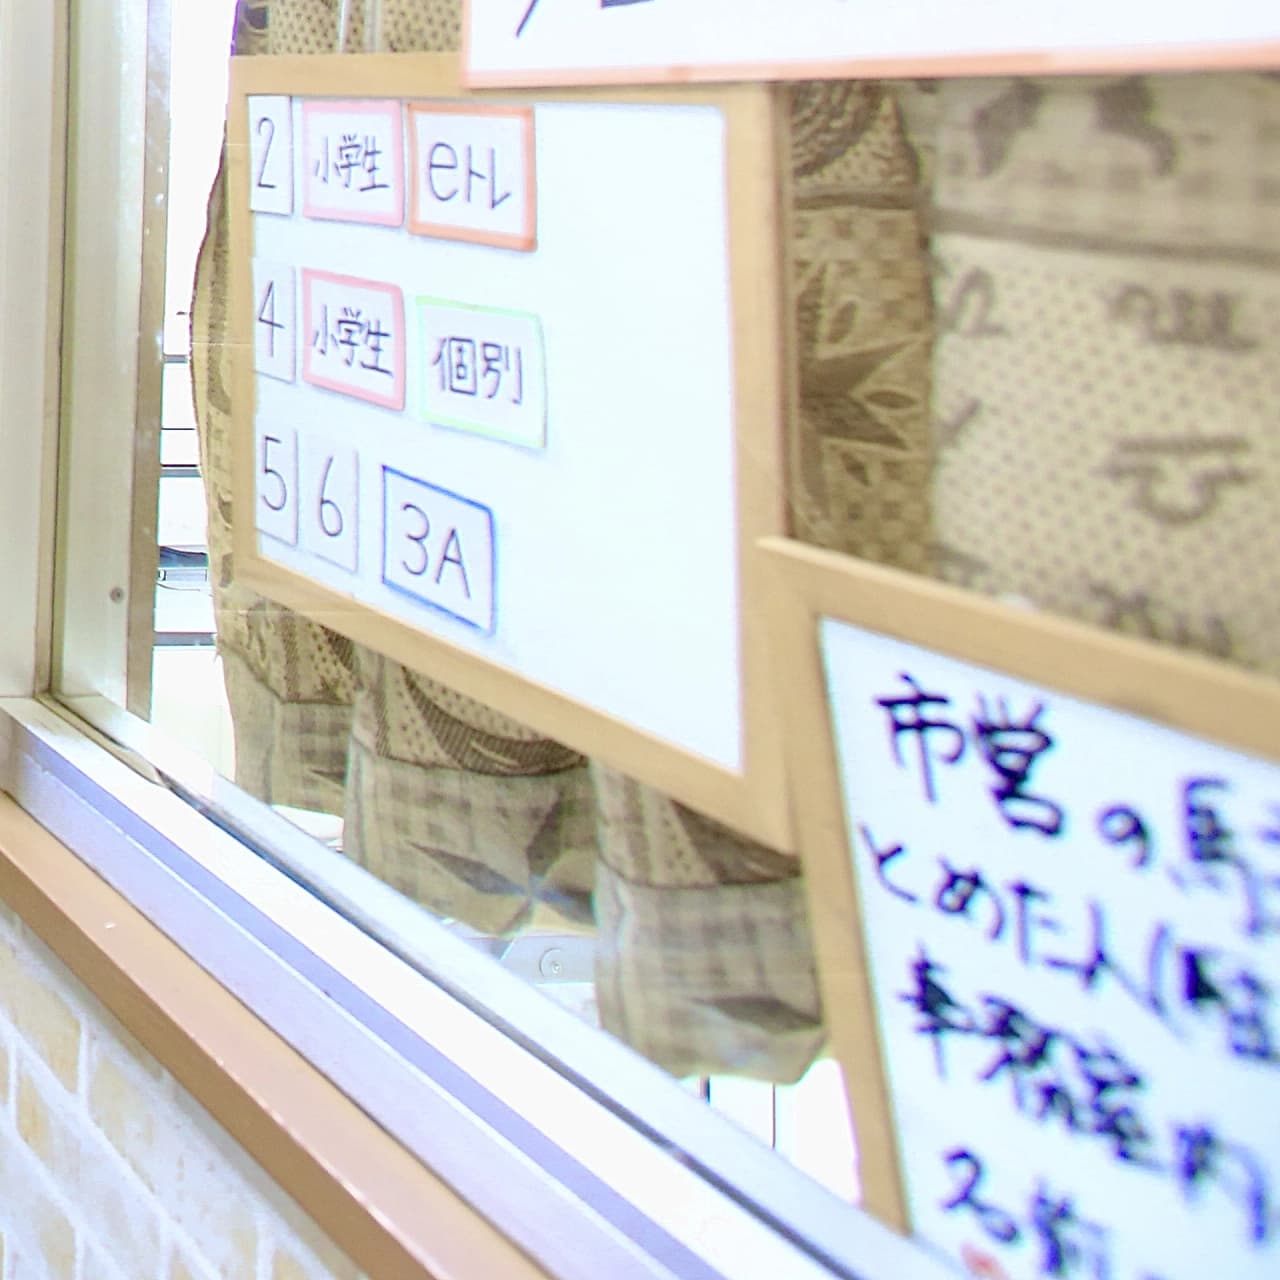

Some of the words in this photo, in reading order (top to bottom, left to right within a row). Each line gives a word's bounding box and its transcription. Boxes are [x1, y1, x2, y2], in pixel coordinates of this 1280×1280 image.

[254, 115, 279, 191] 2
[312, 132, 391, 193] 小学生
[427, 141, 513, 210] eトレ
[257, 280, 285, 359] 4
[312, 304, 394, 377] 小学生
[432, 335, 524, 405] 個別
[260, 434, 288, 512] 5
[318, 454, 344, 539] 6
[401, 502, 472, 601] 3A
